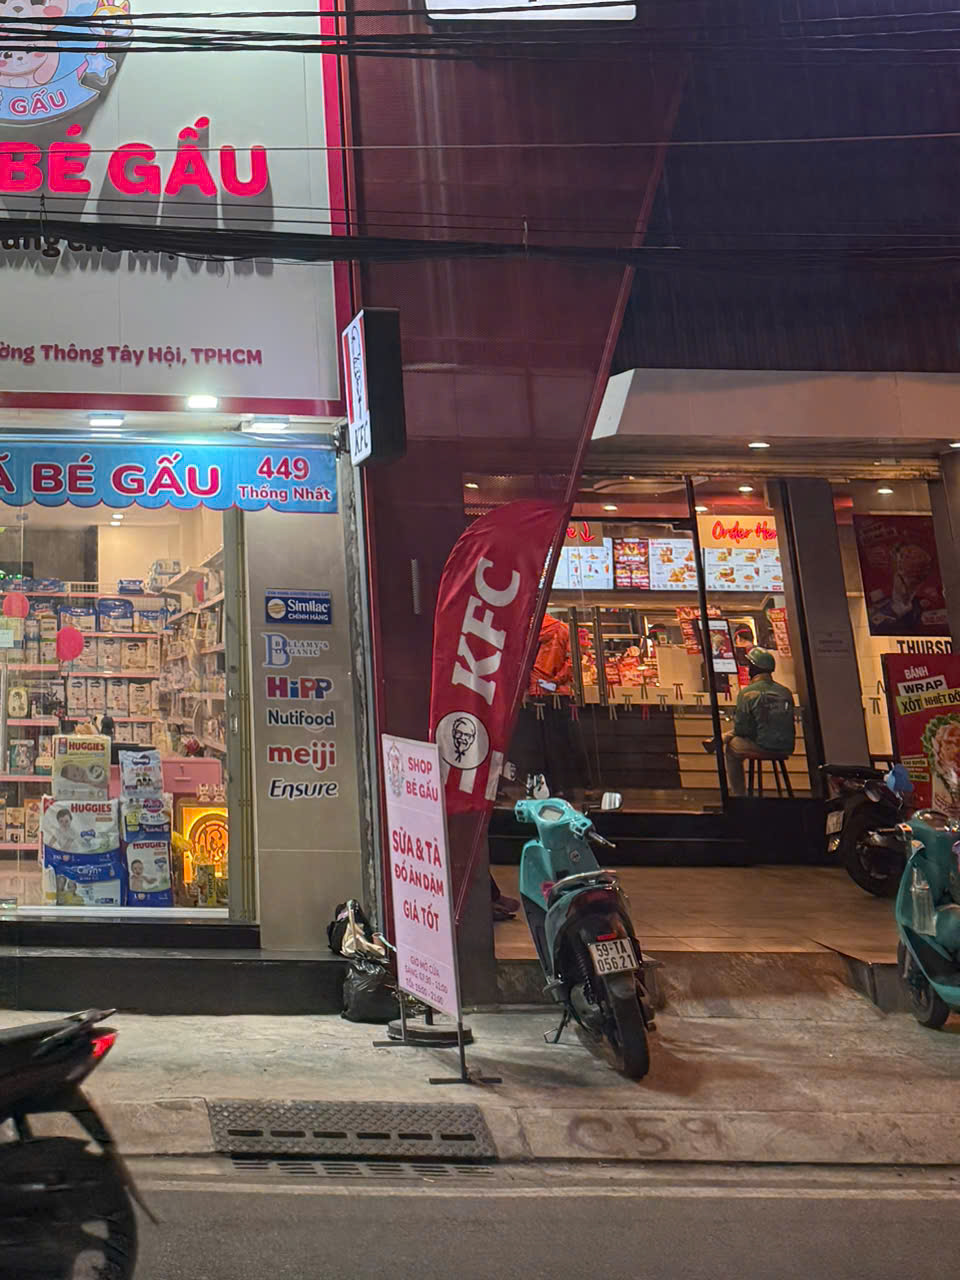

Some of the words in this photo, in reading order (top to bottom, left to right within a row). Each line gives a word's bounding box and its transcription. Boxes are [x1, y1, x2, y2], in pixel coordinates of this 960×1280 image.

[10, 89, 66, 115] GẤU
[106, 116, 269, 197] GẤU
[40, 343, 105, 365] Thông
[107, 344, 144, 366] Tây
[148, 345, 188, 368] Hội,
[190, 347, 263, 365] TPHCM
[31, 453, 96, 495] BÉ
[111, 452, 222, 497] GẤU
[257, 455, 310, 480] 449
[237, 483, 289, 503] Thống
[293, 485, 333, 503] Nhất
[287, 599, 330, 613] Similac
[451, 556, 521, 706] KFC
[904, 666, 929, 680] BÁNH
[266, 676, 333, 700] HiPP
[903, 679, 944, 695] WRAP
[268, 709, 335, 727] Nutifood
[68, 741, 106, 752] HUGGIES
[268, 741, 336, 771] meiji
[407, 756, 433, 775] SHOP
[269, 778, 338, 799] Ensure
[406, 778, 418, 797] BÉ
[419, 780, 439, 803] GẤU
[70, 802, 112, 813] HUGGIES
[416, 838, 425, 862] &
[403, 899, 420, 924] GIÁ
[421, 903, 440, 933] TỐT
[595, 940, 628, 958] 59-TA
[597, 954, 636, 973] 056.21
